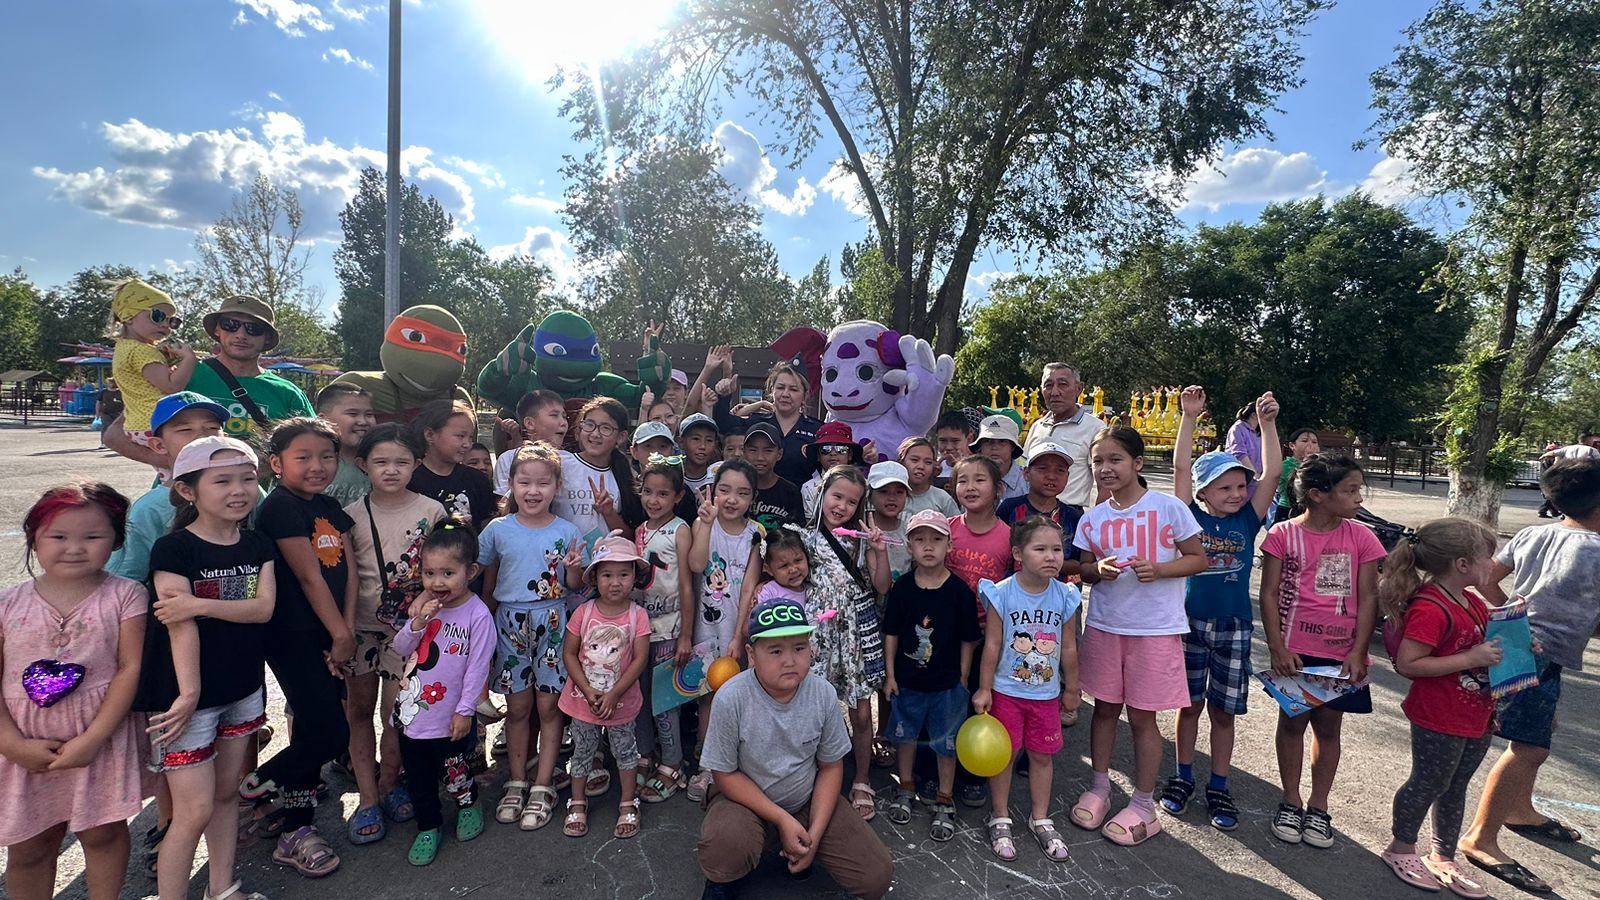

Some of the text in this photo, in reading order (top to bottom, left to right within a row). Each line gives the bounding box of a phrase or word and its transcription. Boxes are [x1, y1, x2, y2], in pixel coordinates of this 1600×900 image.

[570, 503, 598, 516] VEN
[199, 567, 237, 579] Natural
[758, 604, 804, 626] GGG
[1009, 609, 1063, 628] PARIS
[1299, 620, 1324, 635] THIS
[1325, 625, 1349, 638] GIRL
